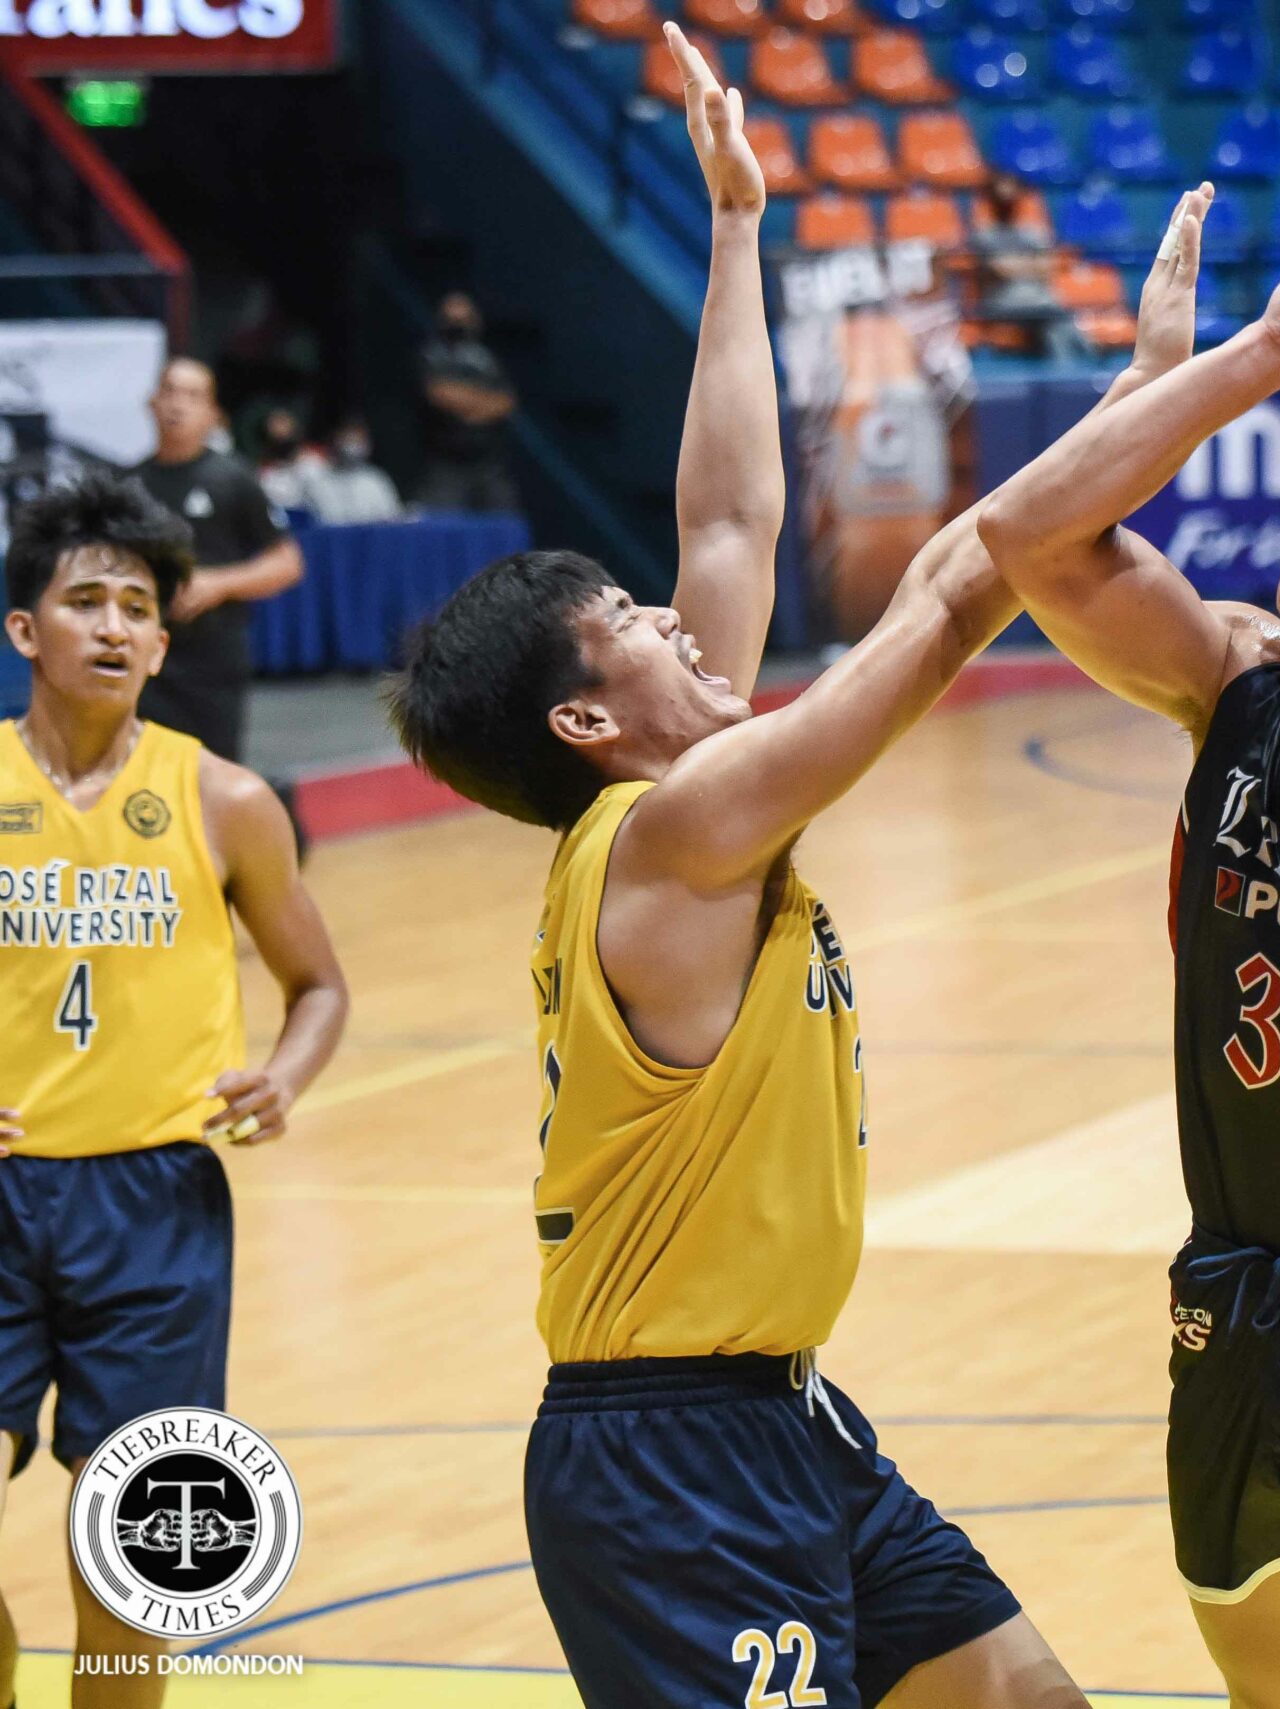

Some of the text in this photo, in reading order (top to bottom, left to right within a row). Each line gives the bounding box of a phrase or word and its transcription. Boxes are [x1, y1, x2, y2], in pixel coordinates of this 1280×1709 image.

[77, 866, 177, 906] RIZAL
[0, 908, 180, 946] NIVERSITY
[55, 961, 97, 1050] 4
[732, 1621, 828, 1709] 22
